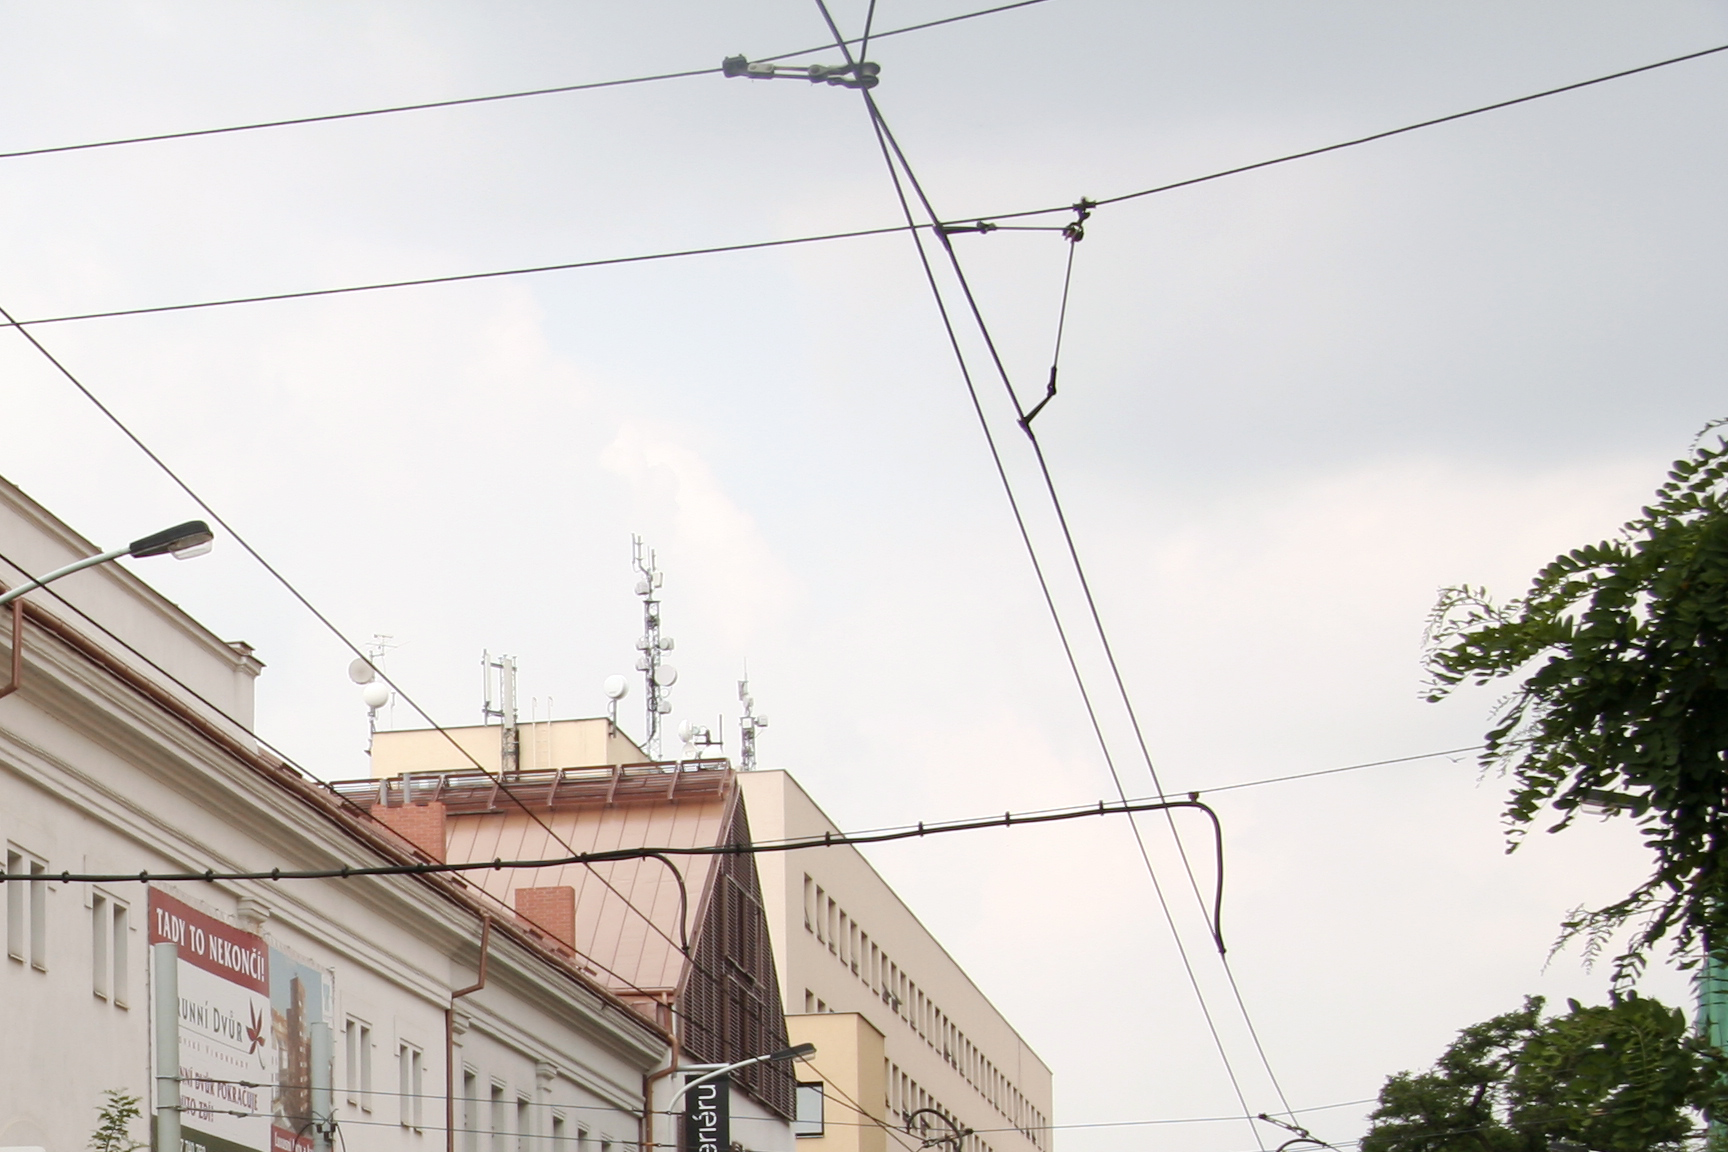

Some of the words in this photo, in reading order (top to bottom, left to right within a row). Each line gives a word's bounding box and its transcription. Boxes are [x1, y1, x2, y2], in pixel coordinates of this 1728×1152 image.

[156, 907, 185, 946] TADY
[189, 925, 205, 955] TO
[209, 934, 264, 982] NEKONČÍ!
